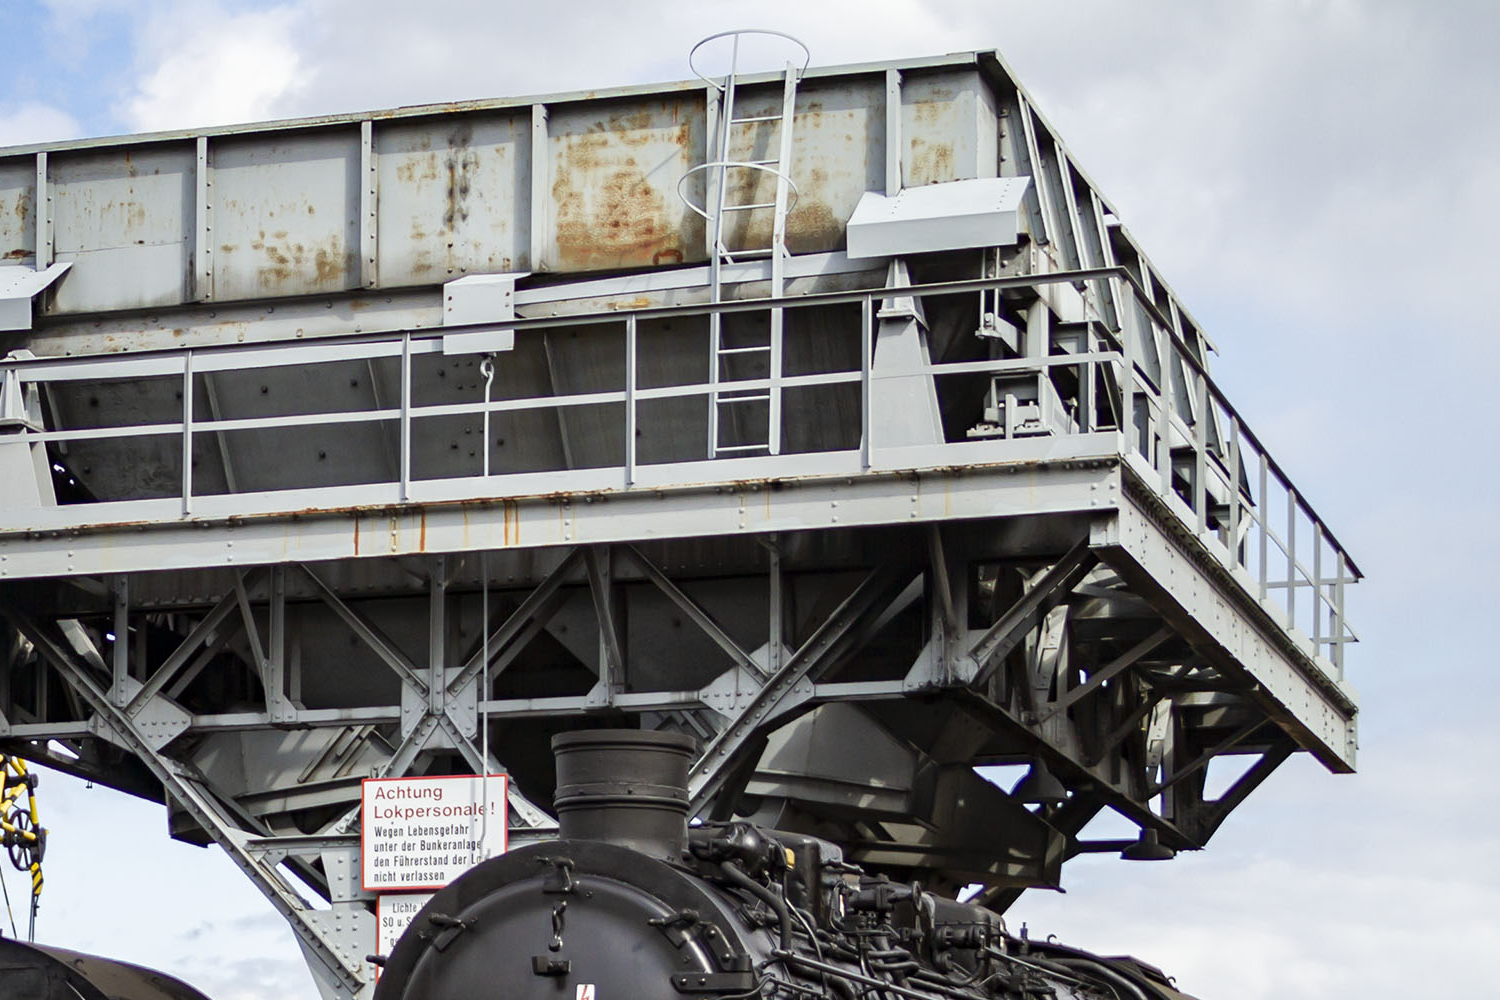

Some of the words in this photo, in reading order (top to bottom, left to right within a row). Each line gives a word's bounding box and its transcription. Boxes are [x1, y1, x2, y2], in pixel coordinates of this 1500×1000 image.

[374, 786, 443, 801] Achtung
[374, 826, 404, 838] Wegen
[407, 824, 469, 838] Lebensgefahr
[374, 841, 398, 852] unter
[401, 840, 416, 852] der
[420, 839, 482, 851] Bunkeranlage
[374, 857, 390, 867] den
[393, 854, 449, 867] Führerstand
[452, 854, 467, 865] der
[471, 853, 482, 865] Lo
[374, 871, 396, 882] nicht
[400, 870, 445, 882] verlassen
[392, 902, 417, 913] Lichte
